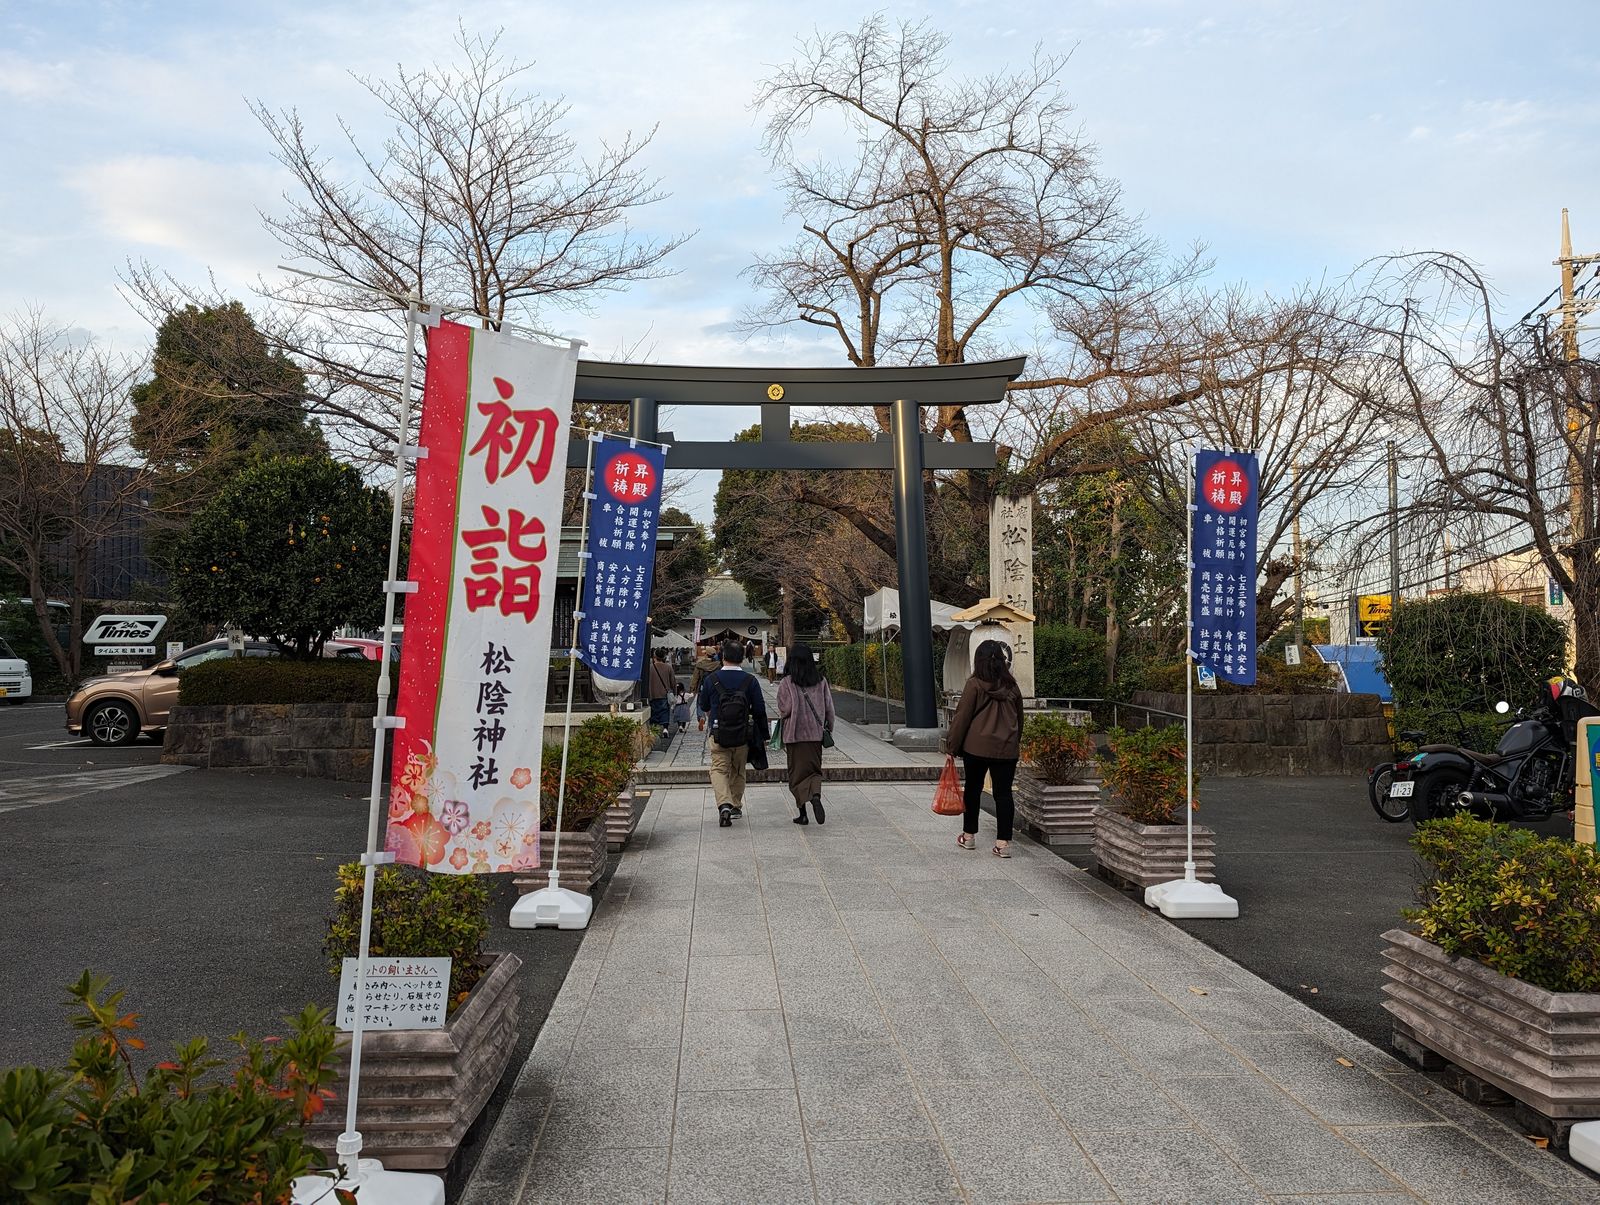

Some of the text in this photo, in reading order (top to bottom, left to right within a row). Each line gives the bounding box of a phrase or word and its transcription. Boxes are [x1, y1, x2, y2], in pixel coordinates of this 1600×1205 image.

[461, 376, 559, 624] 初詣
[632, 463, 648, 497] 昇殿
[1229, 471, 1242, 506] 昇殿
[610, 504, 625, 550] 合格祈願
[624, 507, 639, 551] 開運厄除
[640, 508, 652, 552] 初宮参り
[1215, 514, 1225, 559] 合格祈願
[603, 562, 619, 608] 安産祈願
[618, 564, 632, 608] 八方除け
[633, 565, 646, 610] 七五三参り
[1214, 572, 1224, 617] 安産祈願
[1226, 574, 1236, 618] 八方除け
[1238, 574, 1248, 618] 七五三参り
[98, 625, 151, 639] Times
[611, 621, 625, 668] 身体健康
[623, 622, 639, 669] 家内安全
[1211, 630, 1223, 667] 病気平
[1237, 630, 1248, 675] 家内安全
[467, 641, 515, 791] 松陰神社
